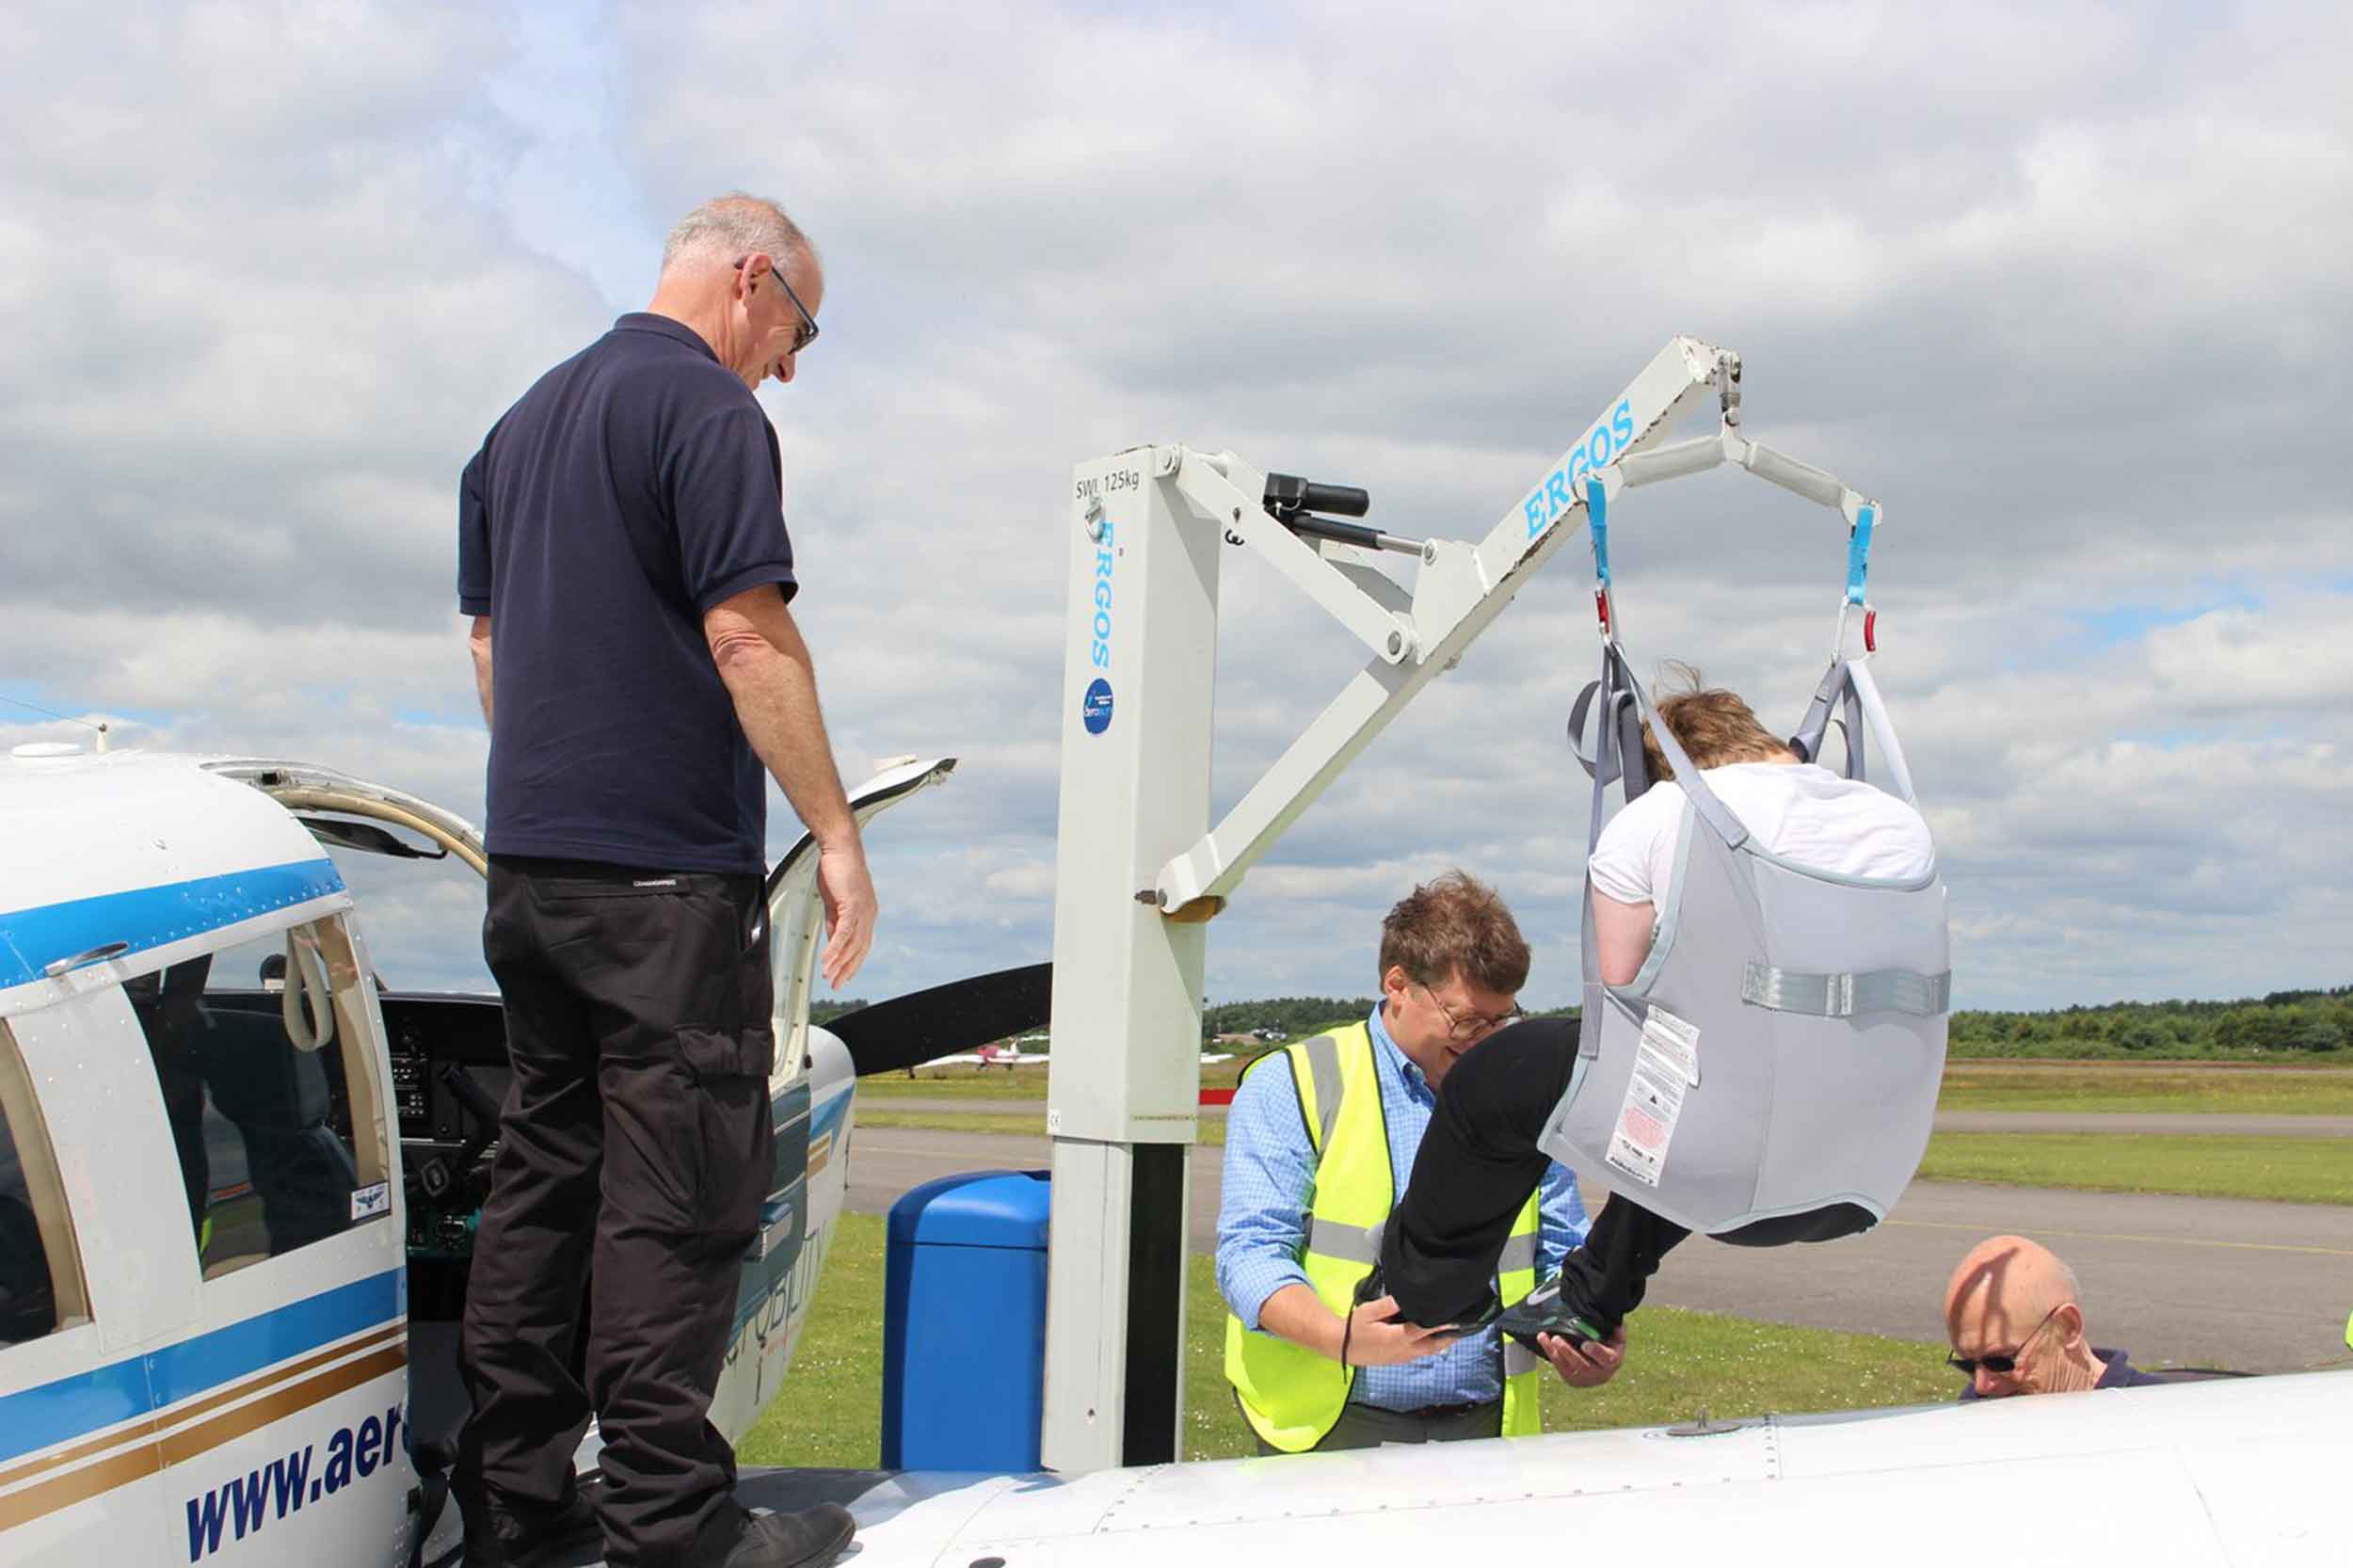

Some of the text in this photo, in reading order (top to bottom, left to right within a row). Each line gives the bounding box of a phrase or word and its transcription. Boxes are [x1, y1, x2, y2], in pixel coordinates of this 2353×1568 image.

[1105, 470, 1139, 491] 125kg
[1523, 399, 1635, 539] ERGOS
[185, 1402, 408, 1563] www.aer
